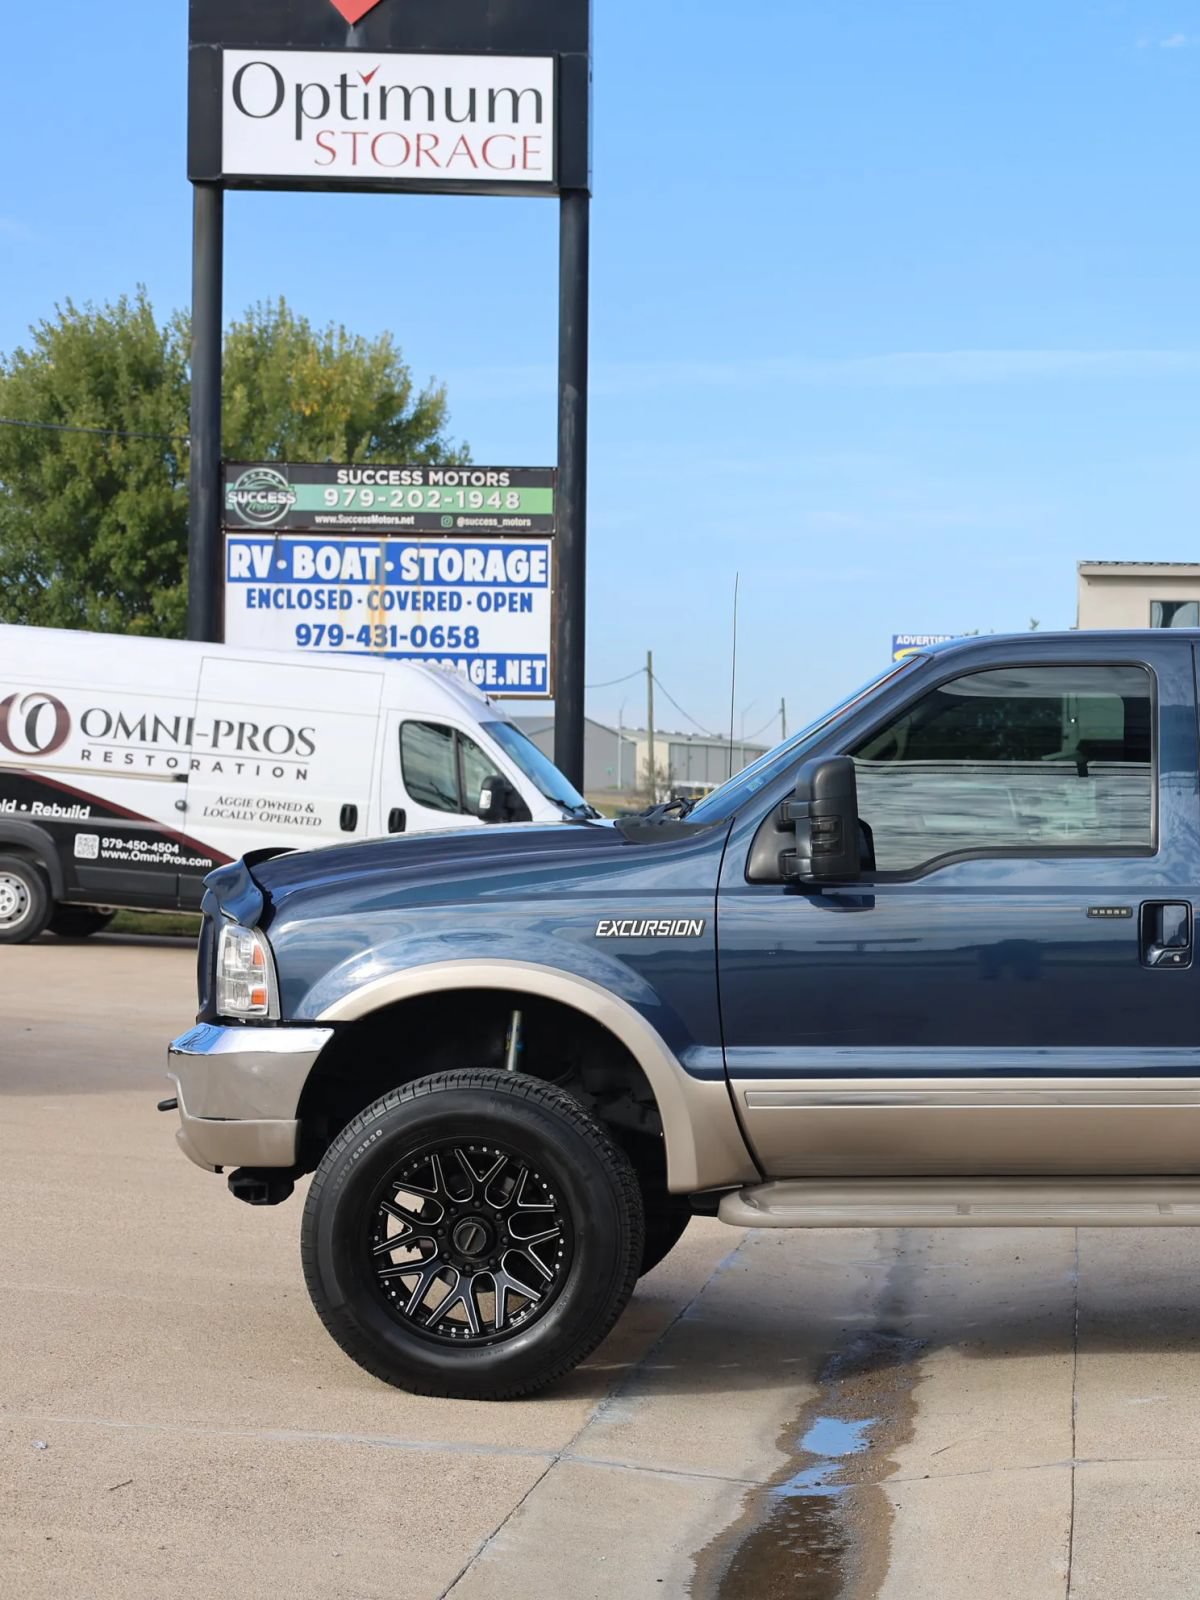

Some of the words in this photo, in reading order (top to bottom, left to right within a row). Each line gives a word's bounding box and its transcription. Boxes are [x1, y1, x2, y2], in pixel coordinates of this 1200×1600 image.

[232, 61, 543, 141] Optimum
[313, 129, 543, 172] STORAGE
[337, 469, 423, 485] SUCCESS
[428, 471, 510, 486] MOTORS
[227, 491, 297, 505] SUCCESS
[323, 487, 520, 510] 979-202-1948
[229, 544, 274, 579] RV
[292, 545, 382, 582] BOAT
[399, 547, 547, 583] STORAGE
[246, 588, 352, 611] ENCLOSED
[367, 590, 462, 612] COVERED
[476, 591, 533, 613] OPEN
[295, 623, 480, 649] 979-431-0658
[79, 708, 317, 758] OMNI-PROS
[80, 749, 309, 781] RESTORATION
[31, 801, 91, 819] Rebuild
[215, 795, 254, 808] AGGIE
[256, 798, 303, 812] OWNED
[203, 806, 257, 821] LOCALLY
[259, 811, 322, 826] OPERATED
[101, 837, 180, 854] 979-450-4504
[101, 849, 212, 867] www.Omni-Pros.com
[595, 919, 704, 936] EXCURSION
